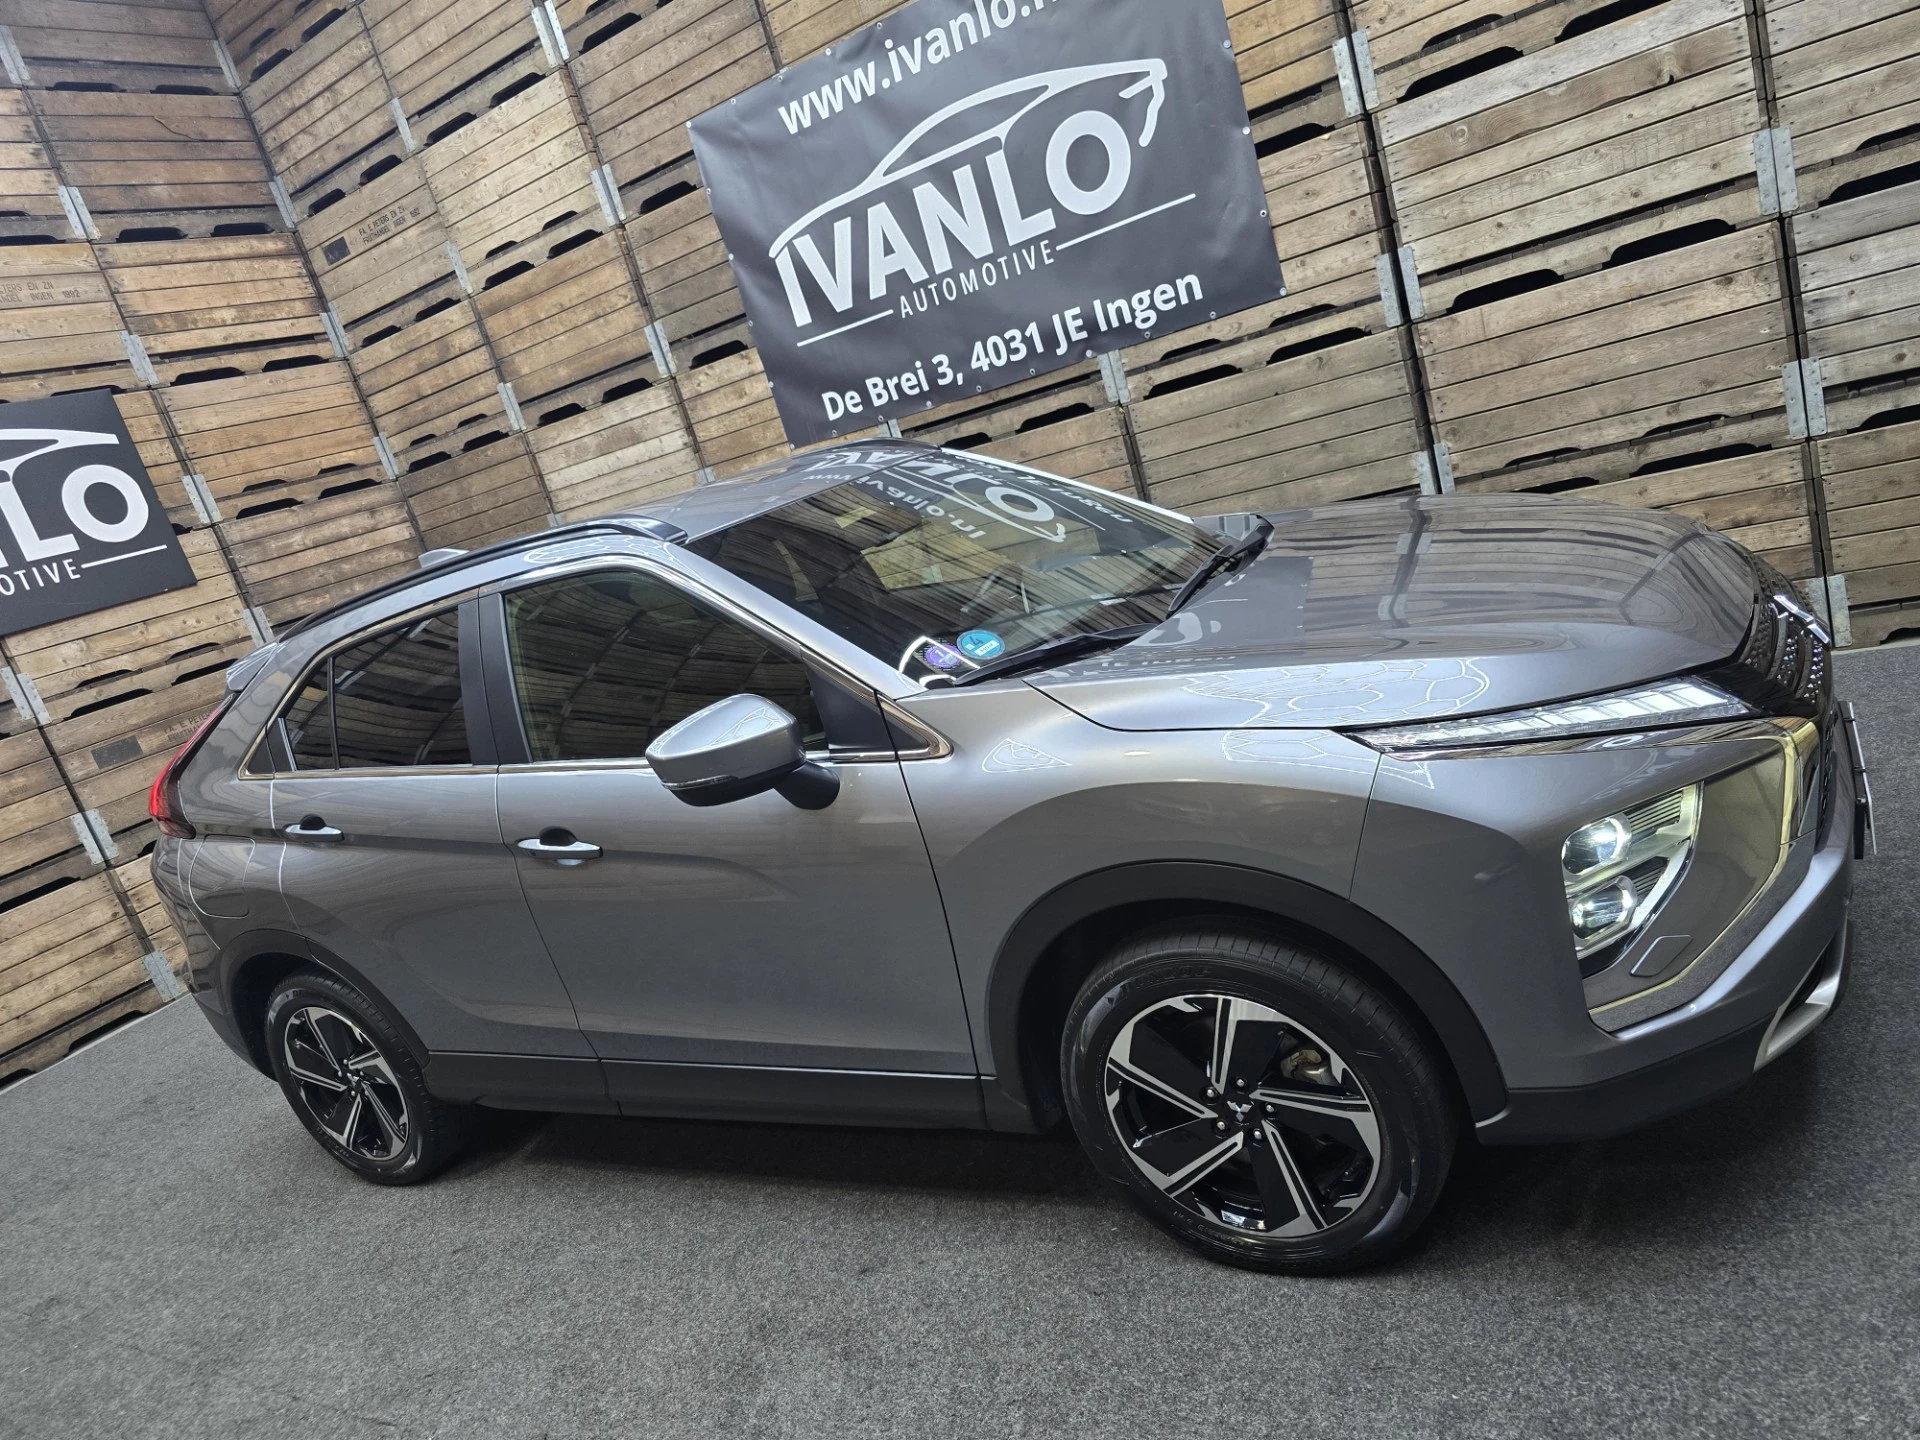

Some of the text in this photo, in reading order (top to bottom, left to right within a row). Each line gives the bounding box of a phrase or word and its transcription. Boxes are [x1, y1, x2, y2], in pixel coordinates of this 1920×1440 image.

[778, 0, 1052, 135] www.ivanlo.
[774, 110, 1132, 327] IVANLO
[900, 240, 1055, 319] AUTOMOTIVE
[821, 273, 1204, 422] De Brei 3, 4031 JE Ingen
[0, 464, 149, 568] LO
